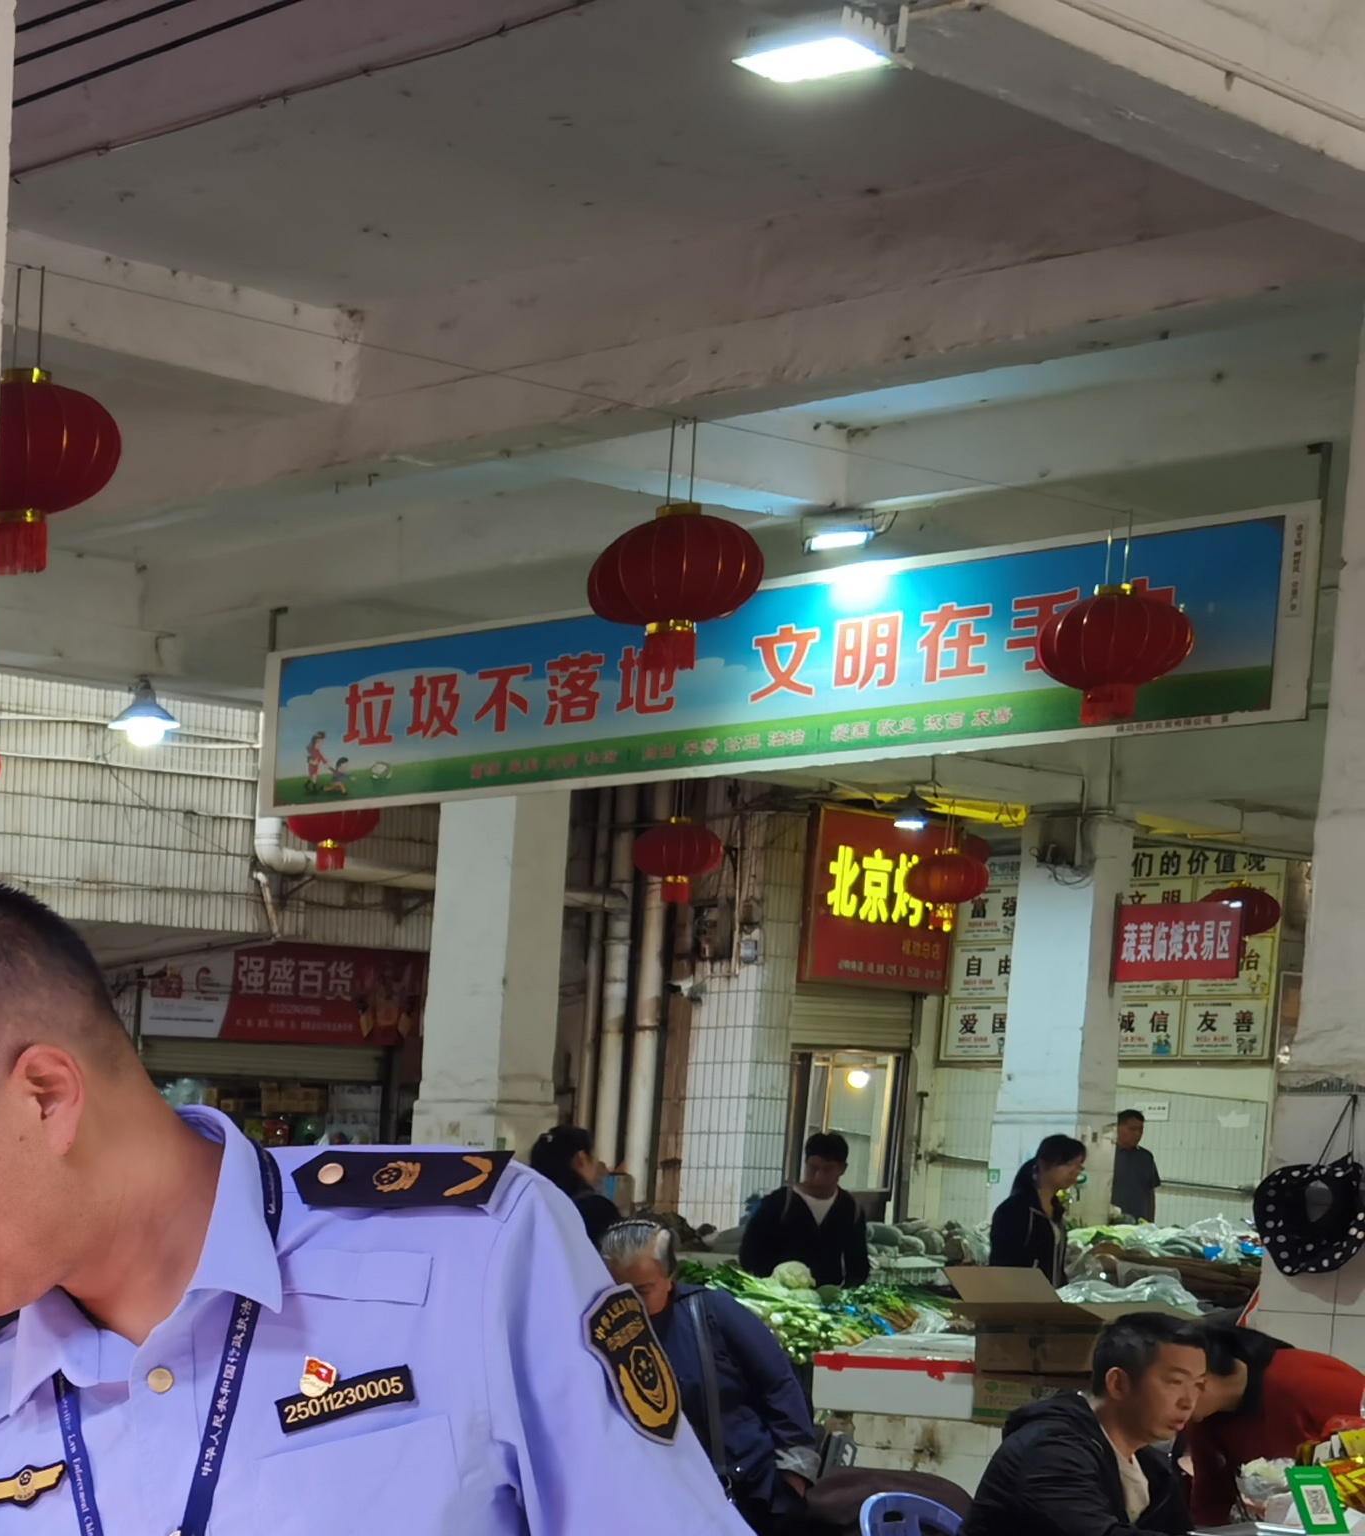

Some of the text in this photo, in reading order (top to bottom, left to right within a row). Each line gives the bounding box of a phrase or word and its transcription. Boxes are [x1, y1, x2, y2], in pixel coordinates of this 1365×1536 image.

[343, 577, 1176, 746] 垃圾不落地 文明在手
[831, 721, 870, 743] 爱国
[876, 717, 917, 736] 敬业
[923, 711, 966, 732] 诚信
[971, 707, 1013, 728] 友善
[238, 955, 355, 1001] 强盛百货
[966, 955, 1011, 977] 自由
[959, 1013, 1007, 1034] 爱国
[1197, 1010, 1255, 1033] 友善
[284, 1376, 404, 1424] 25011230005
